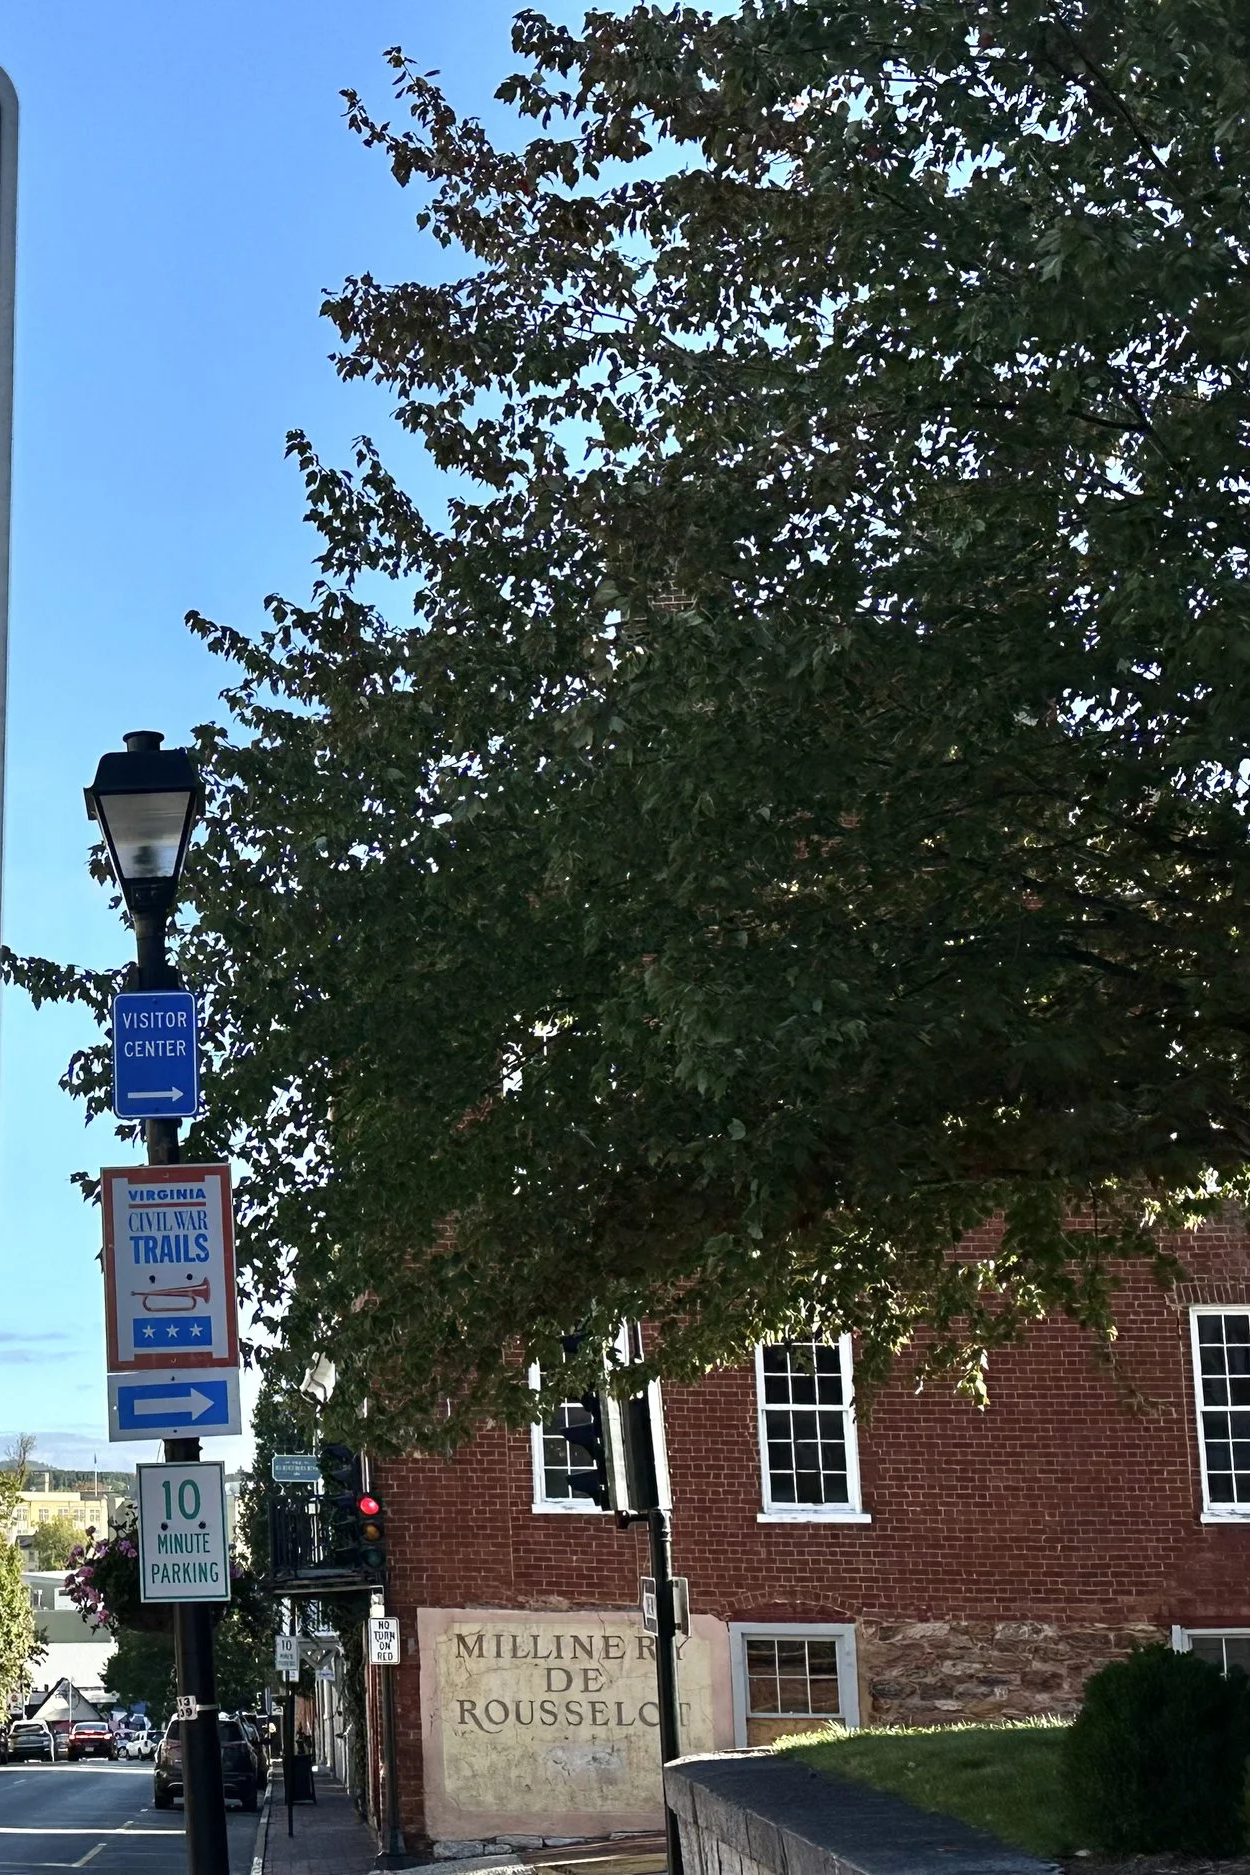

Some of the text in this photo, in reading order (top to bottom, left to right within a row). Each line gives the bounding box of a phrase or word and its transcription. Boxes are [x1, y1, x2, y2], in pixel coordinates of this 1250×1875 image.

[122, 1011, 188, 1029] VISITOR
[124, 1039, 187, 1058] CENTER
[128, 1188, 206, 1201] VIRGINIA
[128, 1210, 208, 1232] CIVIL WAR
[129, 1233, 210, 1264] TRAILS
[161, 1478, 201, 1521] 10
[157, 1533, 210, 1555] MINUTE
[151, 1561, 219, 1584] PARKING
[378, 1620, 390, 1630] NO
[281, 1639, 292, 1651] 10
[543, 1666, 605, 1693] DE
